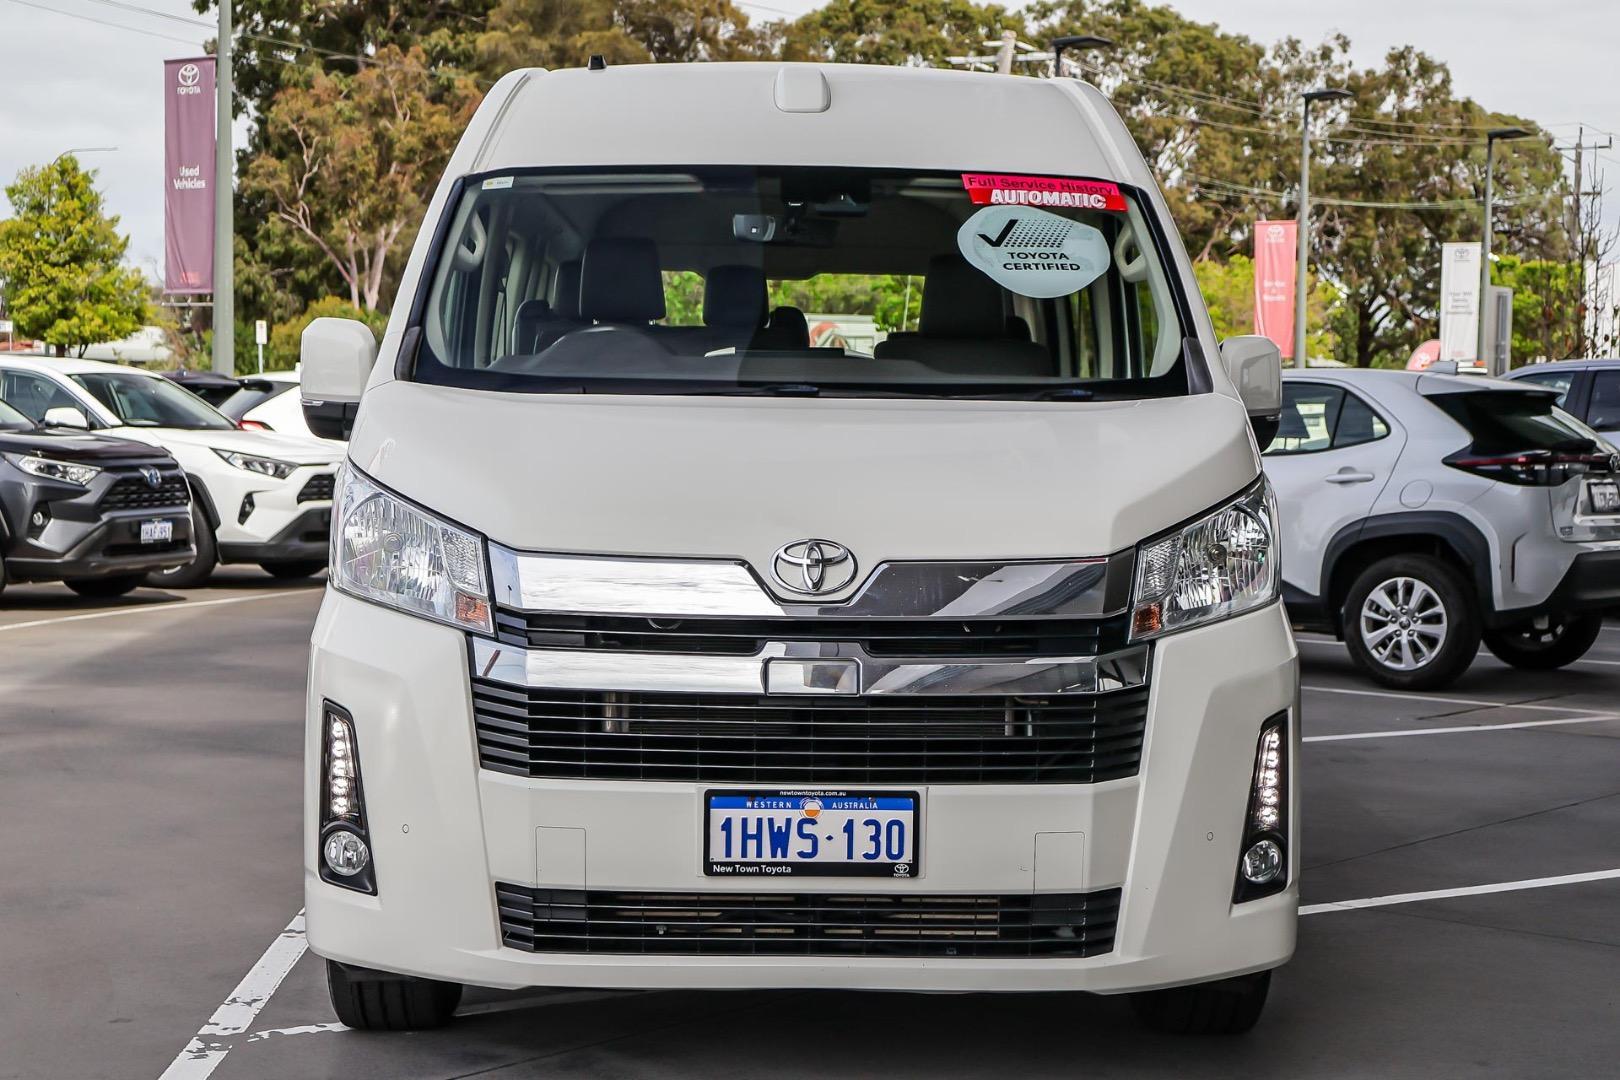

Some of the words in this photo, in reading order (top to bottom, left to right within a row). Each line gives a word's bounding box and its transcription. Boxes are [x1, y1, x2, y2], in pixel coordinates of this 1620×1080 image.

[177, 86, 201, 95] TOYOTA
[180, 165, 200, 176] Used
[173, 178, 206, 189] Vehicles
[967, 176, 996, 187] Full
[1001, 178, 1056, 190] Service
[1061, 183, 1113, 195] History
[990, 189, 1107, 209] AUTOMATIC
[1007, 252, 1069, 260] TOYOTA
[1003, 262, 1080, 271] CERTIFIED
[746, 801, 792, 809] WESTERN
[713, 864, 733, 873] New
[734, 864, 759, 873] Town
[760, 864, 792, 874] Toyota
